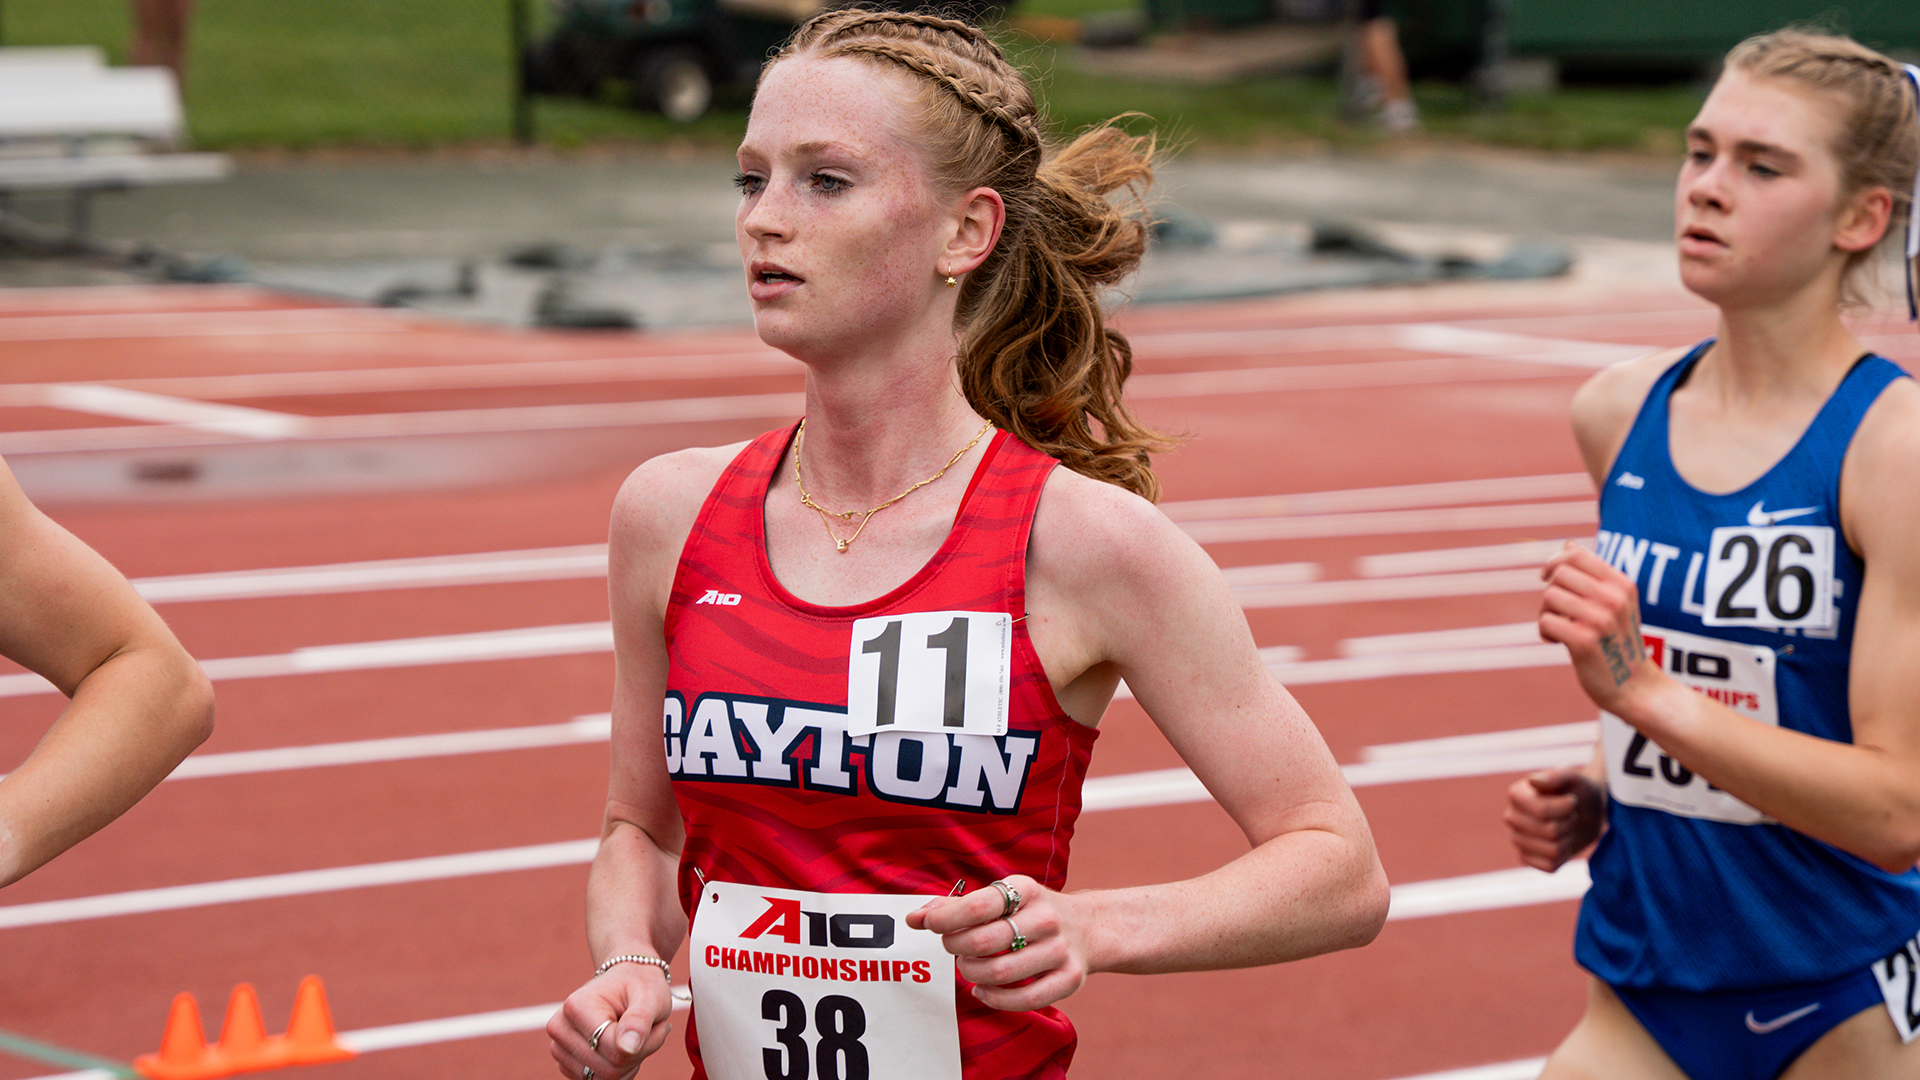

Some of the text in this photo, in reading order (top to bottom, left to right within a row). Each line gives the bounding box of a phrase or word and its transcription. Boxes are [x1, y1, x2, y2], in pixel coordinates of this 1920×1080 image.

[695, 589, 742, 606] A10
[1715, 534, 1815, 621] 26
[862, 616, 969, 728] 11
[737, 896, 895, 949] A10
[705, 945, 932, 983] CHAMPIONSHIPS
[761, 989, 870, 1080] 38
